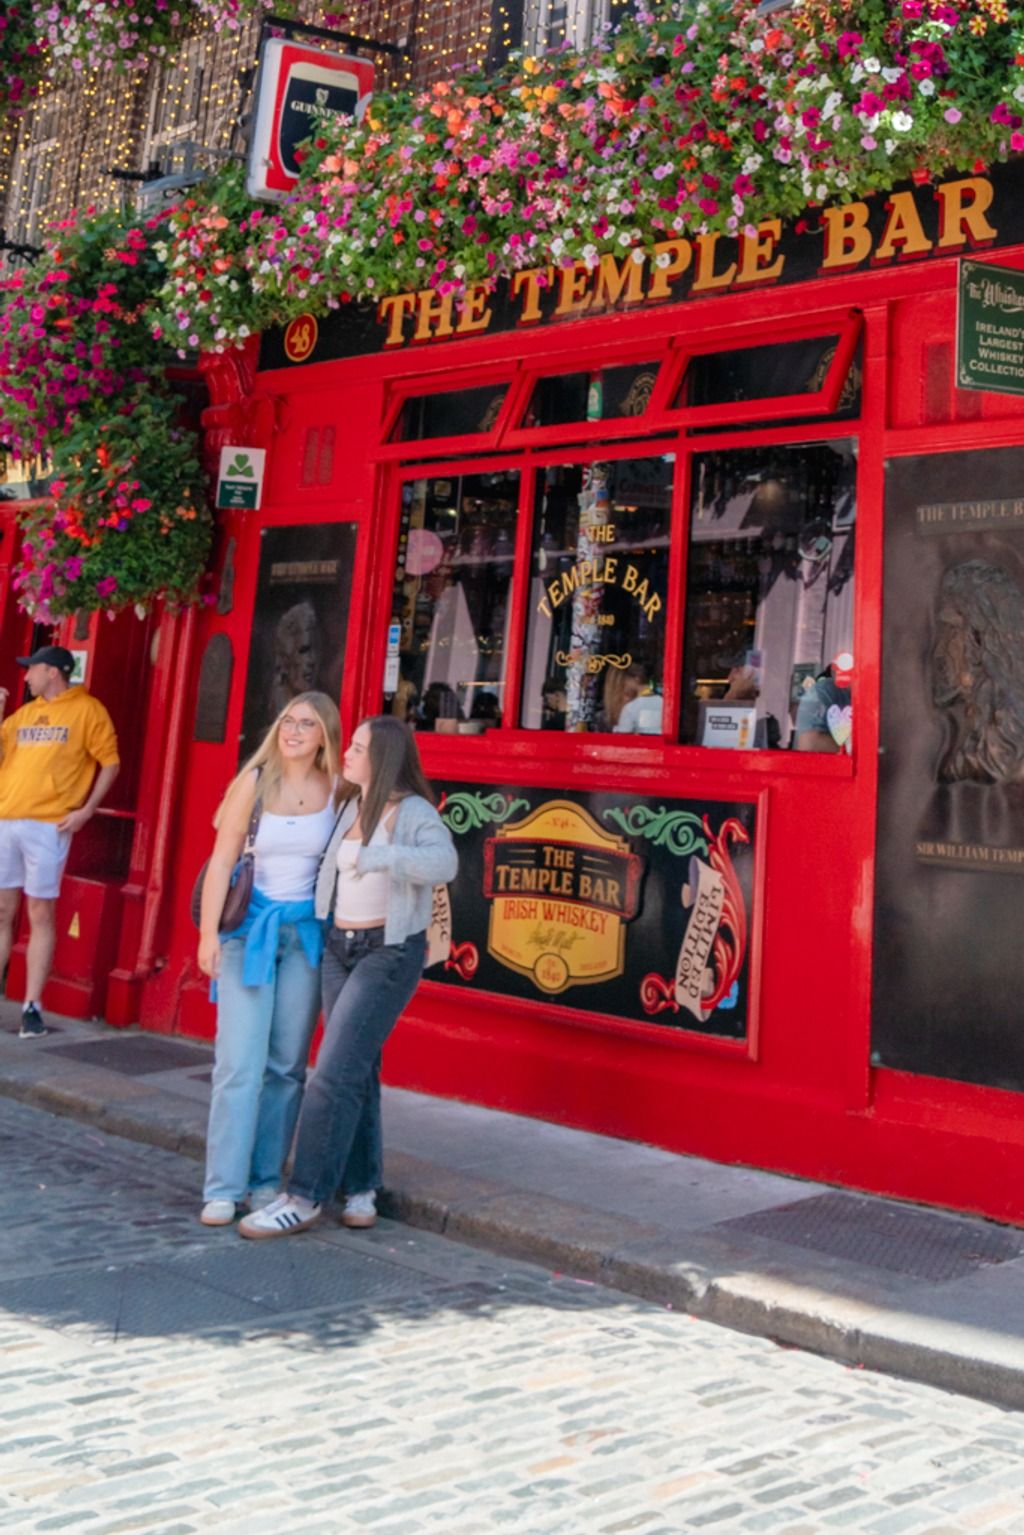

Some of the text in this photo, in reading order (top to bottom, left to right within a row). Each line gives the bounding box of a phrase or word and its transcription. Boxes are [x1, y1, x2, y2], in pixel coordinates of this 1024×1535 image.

[378, 175, 999, 348] THE TEMPLE BAR
[967, 281, 981, 300] The
[290, 323, 311, 354] 48
[979, 335, 1024, 352] LARGEST
[978, 348, 1024, 364] WHISKEY
[917, 506, 946, 522] THE
[951, 503, 1010, 521] TEMPLE
[587, 524, 616, 543] THE
[536, 556, 662, 624] TEMPLE BAR
[543, 846, 576, 869] THE
[936, 843, 990, 861] WILLIAM
[496, 865, 623, 909] TEMPLE BAR
[503, 899, 538, 921] IRISH
[542, 901, 610, 935] WHISKEY
[678, 891, 710, 989] EDITION
[689, 885, 722, 1000] LIMITED
